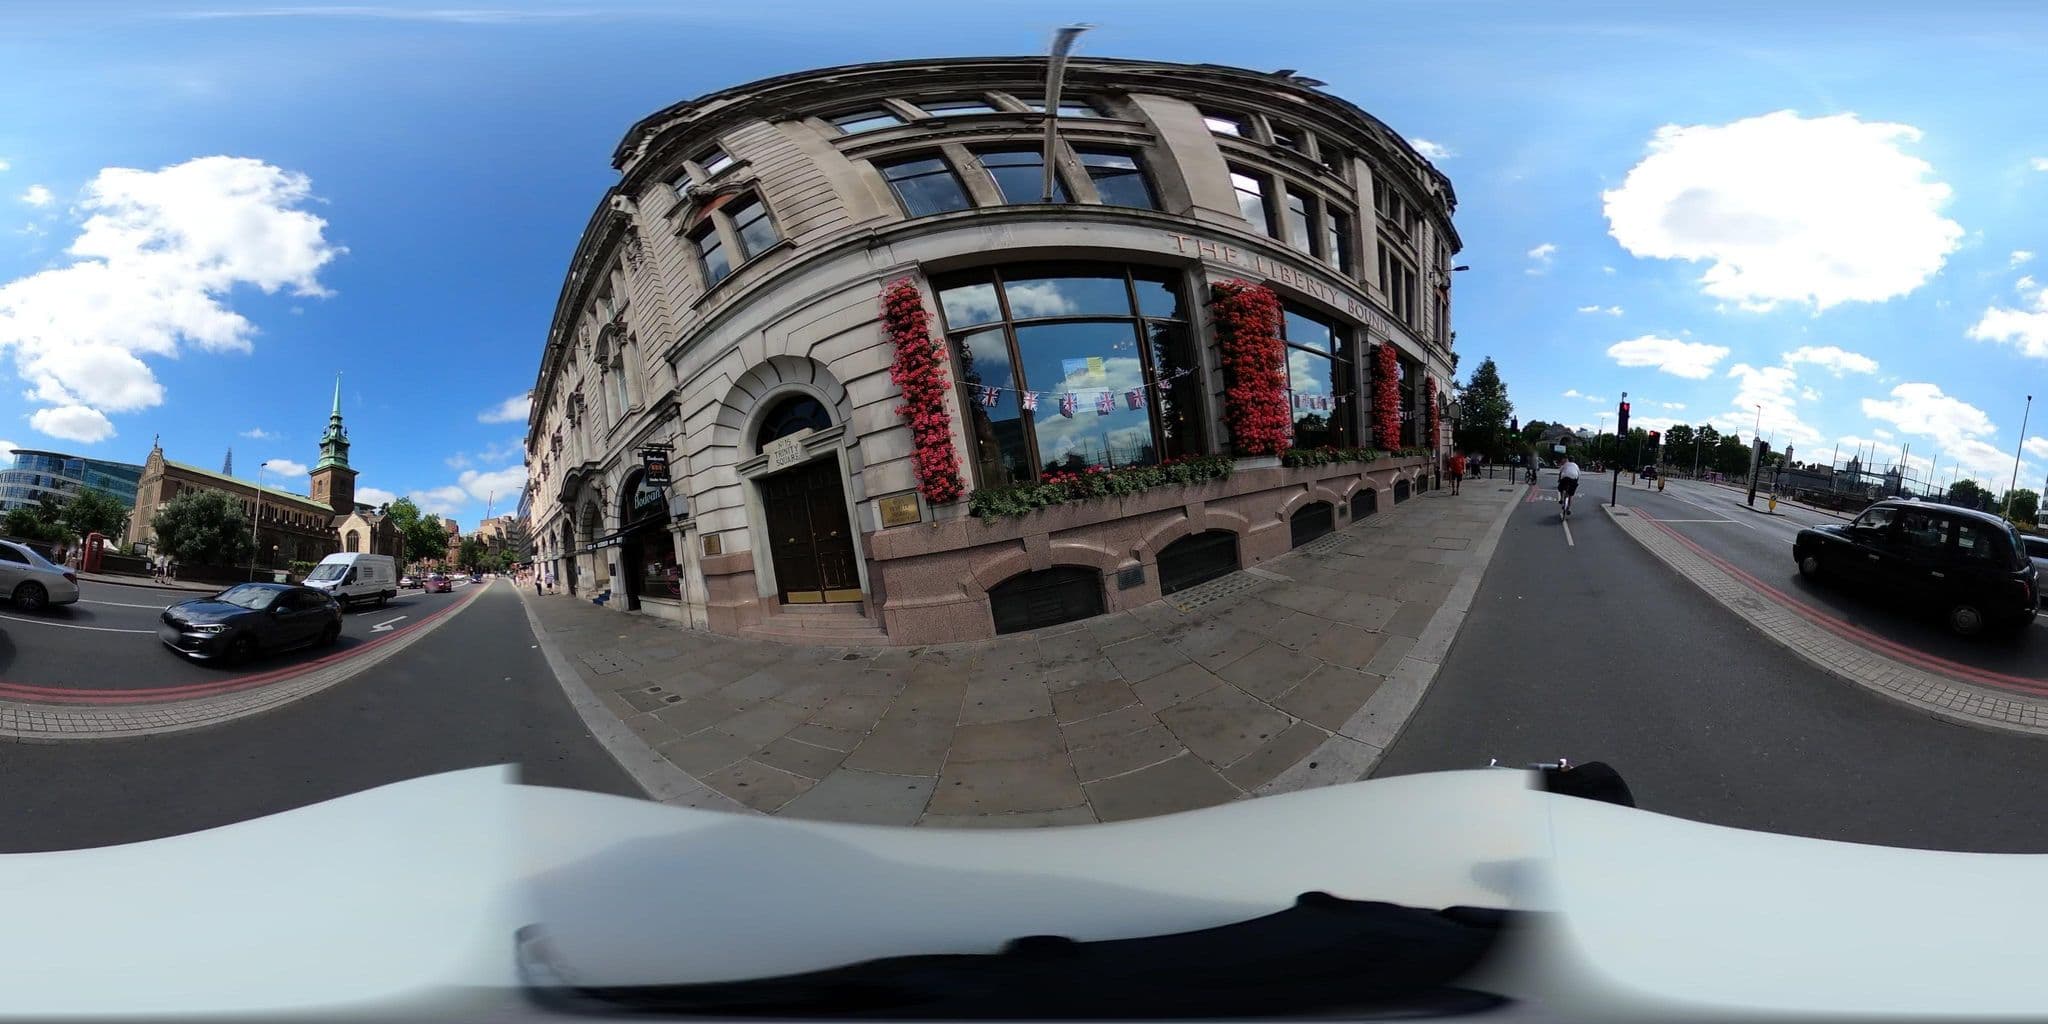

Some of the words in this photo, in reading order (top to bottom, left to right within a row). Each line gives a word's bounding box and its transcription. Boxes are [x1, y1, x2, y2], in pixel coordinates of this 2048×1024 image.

[1168, 233, 1238, 264] THE
[1256, 256, 1338, 304] LIBERTY
[1347, 296, 1391, 335] BOUNDS
[775, 443, 799, 460] TRINITY
[776, 452, 800, 467] SQUARE
